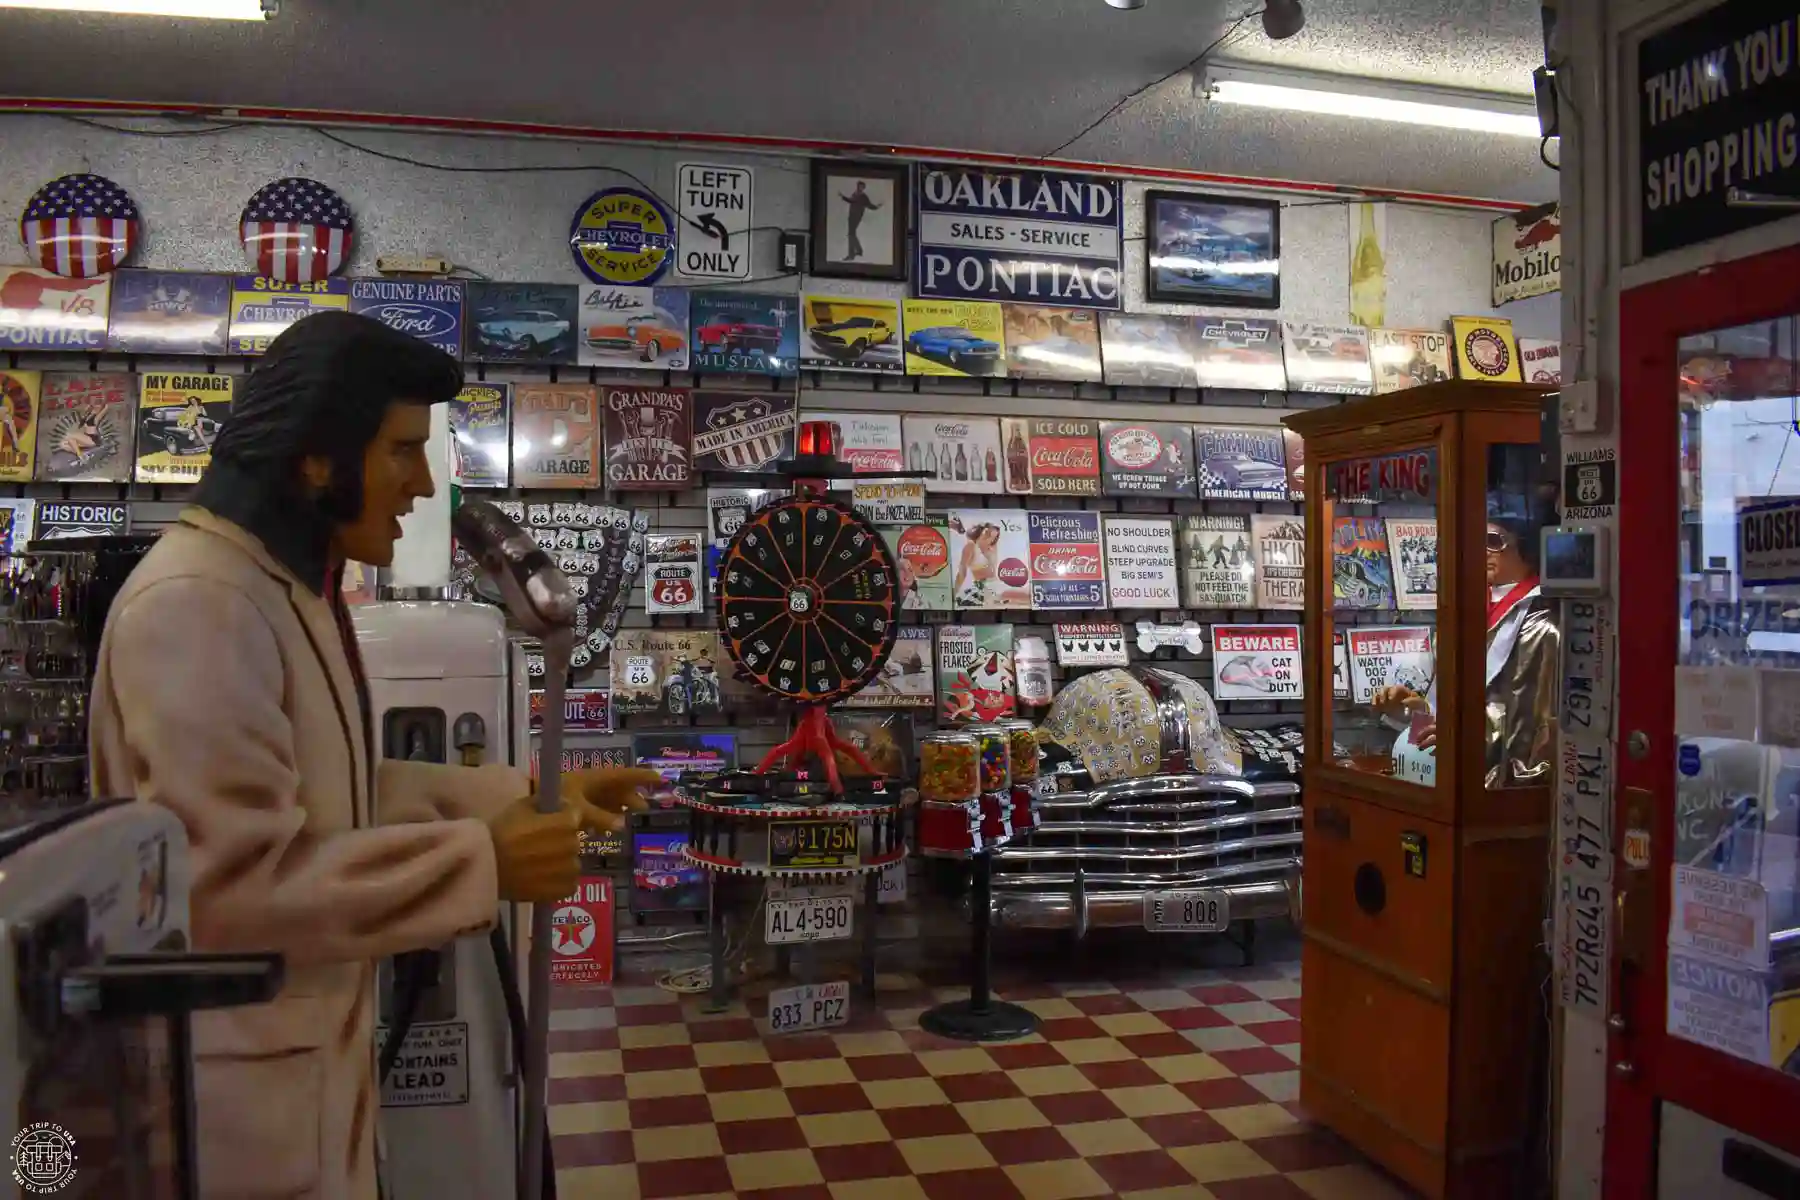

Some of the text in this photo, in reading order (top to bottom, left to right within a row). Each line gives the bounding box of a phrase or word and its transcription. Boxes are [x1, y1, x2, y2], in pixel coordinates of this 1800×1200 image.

[1646, 20, 1790, 126] THANK YOU
[1647, 112, 1796, 210] SHOPPING
[689, 170, 741, 190] LEFT
[687, 190, 744, 210] TURN
[924, 171, 1114, 219] OAKLAND
[591, 201, 657, 224] SUPER
[951, 222, 1090, 248] SALES SERVICE
[585, 248, 657, 272] SERVICE
[687, 251, 740, 273] ONLY
[924, 254, 1118, 300] PONTIAC
[1495, 253, 1560, 288] Mobilo
[353, 281, 414, 300] GENUINE
[418, 283, 461, 303] PARTS
[381, 307, 436, 331] Ford
[0, 327, 98, 345] PONTIAC
[1208, 328, 1265, 339] CHEVROLET
[1412, 335, 1445, 353] STOP
[695, 354, 797, 371] MUSTANG
[809, 358, 897, 370] MUSTANG
[146, 376, 230, 392] MY GARAGE
[609, 391, 684, 411] GRANDPA'S
[696, 410, 795, 450] MADE IN AMERICA
[1036, 423, 1089, 436] ICE COLD
[1200, 433, 1280, 461] CAMARO
[1566, 449, 1615, 463] WILLIAMS
[527, 460, 590, 474] ARAGE
[609, 464, 688, 481] GARAGE
[1038, 477, 1096, 492] SOLD HERE
[1334, 455, 1429, 501] THE KING
[1205, 488, 1250, 499] AMERICAN
[1582, 487, 1597, 500] 66
[712, 497, 749, 507] HISTORIC
[42, 505, 124, 522] HISTORIC
[532, 514, 547, 524] 66
[556, 512, 571, 522] 66
[575, 513, 589, 524] 66
[1565, 507, 1613, 520] ARIZONA
[595, 516, 609, 526] 66
[614, 518, 627, 529] 66
[1001, 519, 1022, 532] Yes
[1031, 514, 1081, 528] Delicious
[1188, 516, 1244, 529] WARNING!
[1042, 528, 1099, 541] Refreshing
[1108, 528, 1170, 537] NO SHOULDER
[1396, 526, 1413, 538] BAD
[538, 539, 552, 549] 66
[559, 538, 573, 549] 66
[588, 538, 602, 549] 66
[1112, 545, 1168, 553] BLIND CURVES
[1261, 541, 1304, 565] HIKIN
[563, 560, 577, 571] 66
[582, 561, 595, 573] 66
[1109, 558, 1174, 567] STEEP UPGRADE
[660, 569, 687, 577] ROUTE
[1200, 571, 1241, 581] PLEASE DO
[1112, 588, 1140, 598] GOOD
[1195, 582, 1248, 593] NOT FEED THE
[1263, 580, 1304, 597] THERA
[660, 587, 686, 602] 66
[794, 599, 805, 608] 66
[1060, 624, 1119, 634] WARNING
[589, 638, 600, 650] 66
[642, 639, 675, 651] Route
[678, 639, 692, 650] 66
[940, 641, 973, 655] FROSTED
[1219, 636, 1295, 650] BEWARE
[1353, 639, 1426, 655] BEWARE
[575, 655, 588, 665] 66
[943, 655, 971, 669] FLAKES
[1272, 657, 1292, 668] CAT
[1354, 657, 1391, 669] WATCH
[529, 664, 542, 674] 66
[1276, 670, 1290, 680] ON
[1362, 669, 1384, 680] DOG
[632, 672, 649, 684] 66
[1269, 683, 1298, 693] DUTY
[1367, 680, 1381, 690] ON
[564, 702, 585, 719] UTE
[589, 706, 605, 718] 66
[1577, 746, 1603, 870] 477 PKL
[587, 883, 608, 902] OIL
[1184, 900, 1217, 923] 808
[1575, 885, 1600, 1006] 7PZR645
[772, 999, 845, 1030] 833 PCZ
[392, 1053, 458, 1069] ONTAINS
[393, 1072, 445, 1089] LEAD
